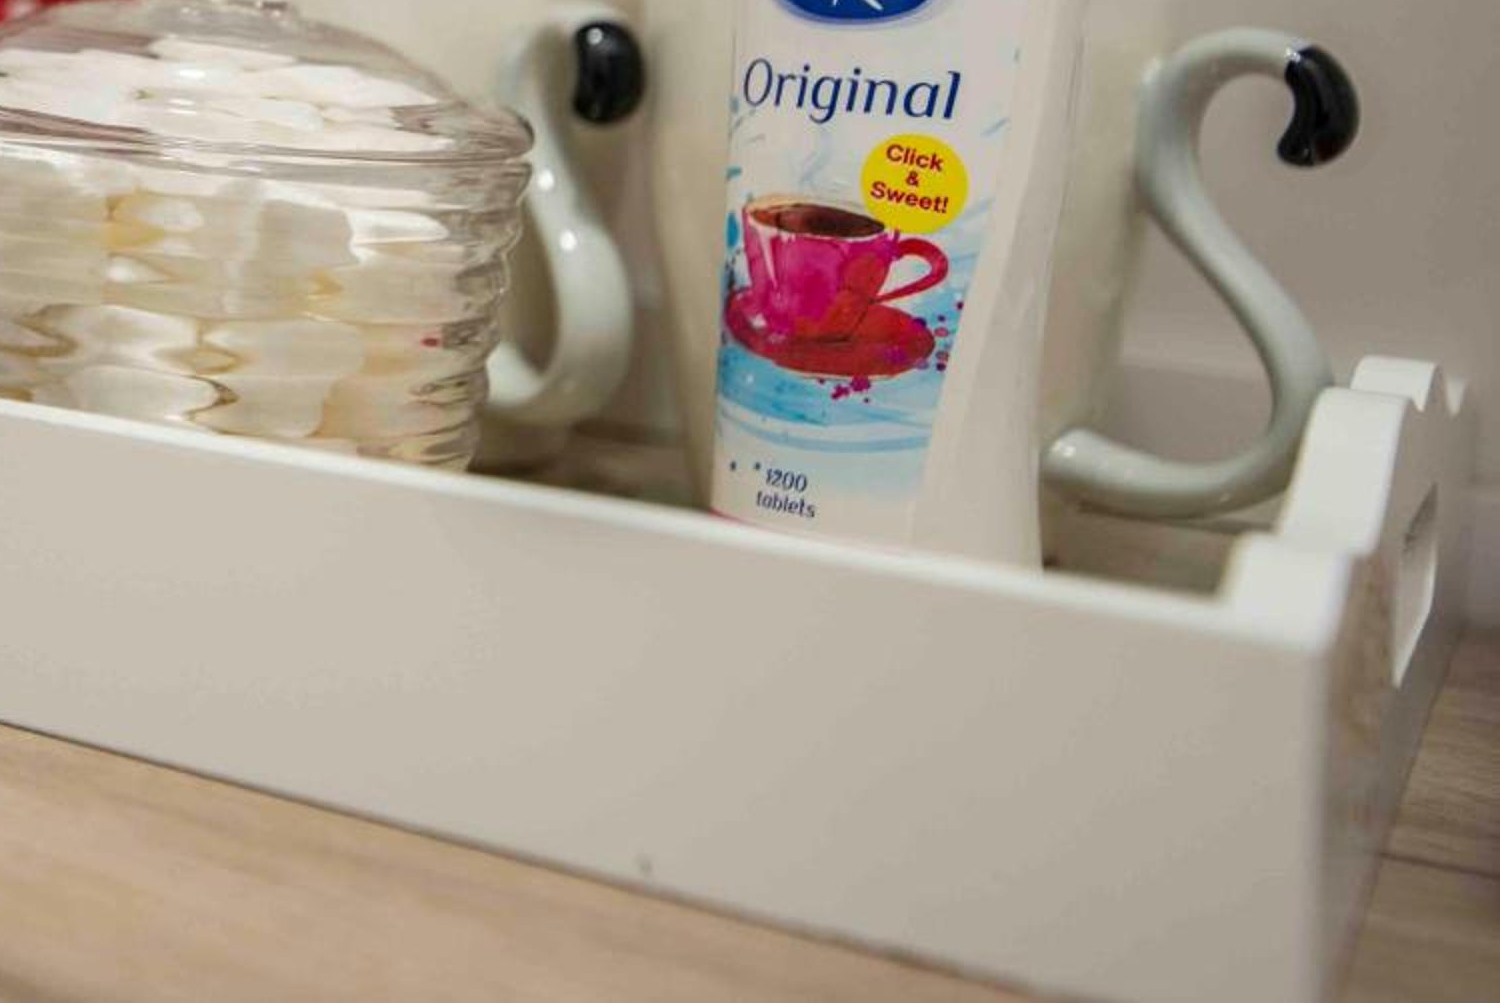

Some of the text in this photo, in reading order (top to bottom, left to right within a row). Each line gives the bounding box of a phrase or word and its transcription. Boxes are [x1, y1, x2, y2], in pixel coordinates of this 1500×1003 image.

[743, 57, 961, 124] Original
[886, 143, 944, 172] Click
[904, 170, 920, 187] &
[870, 180, 949, 214] Sweet!
[765, 468, 808, 493] 1200
[756, 490, 816, 518] tablets
